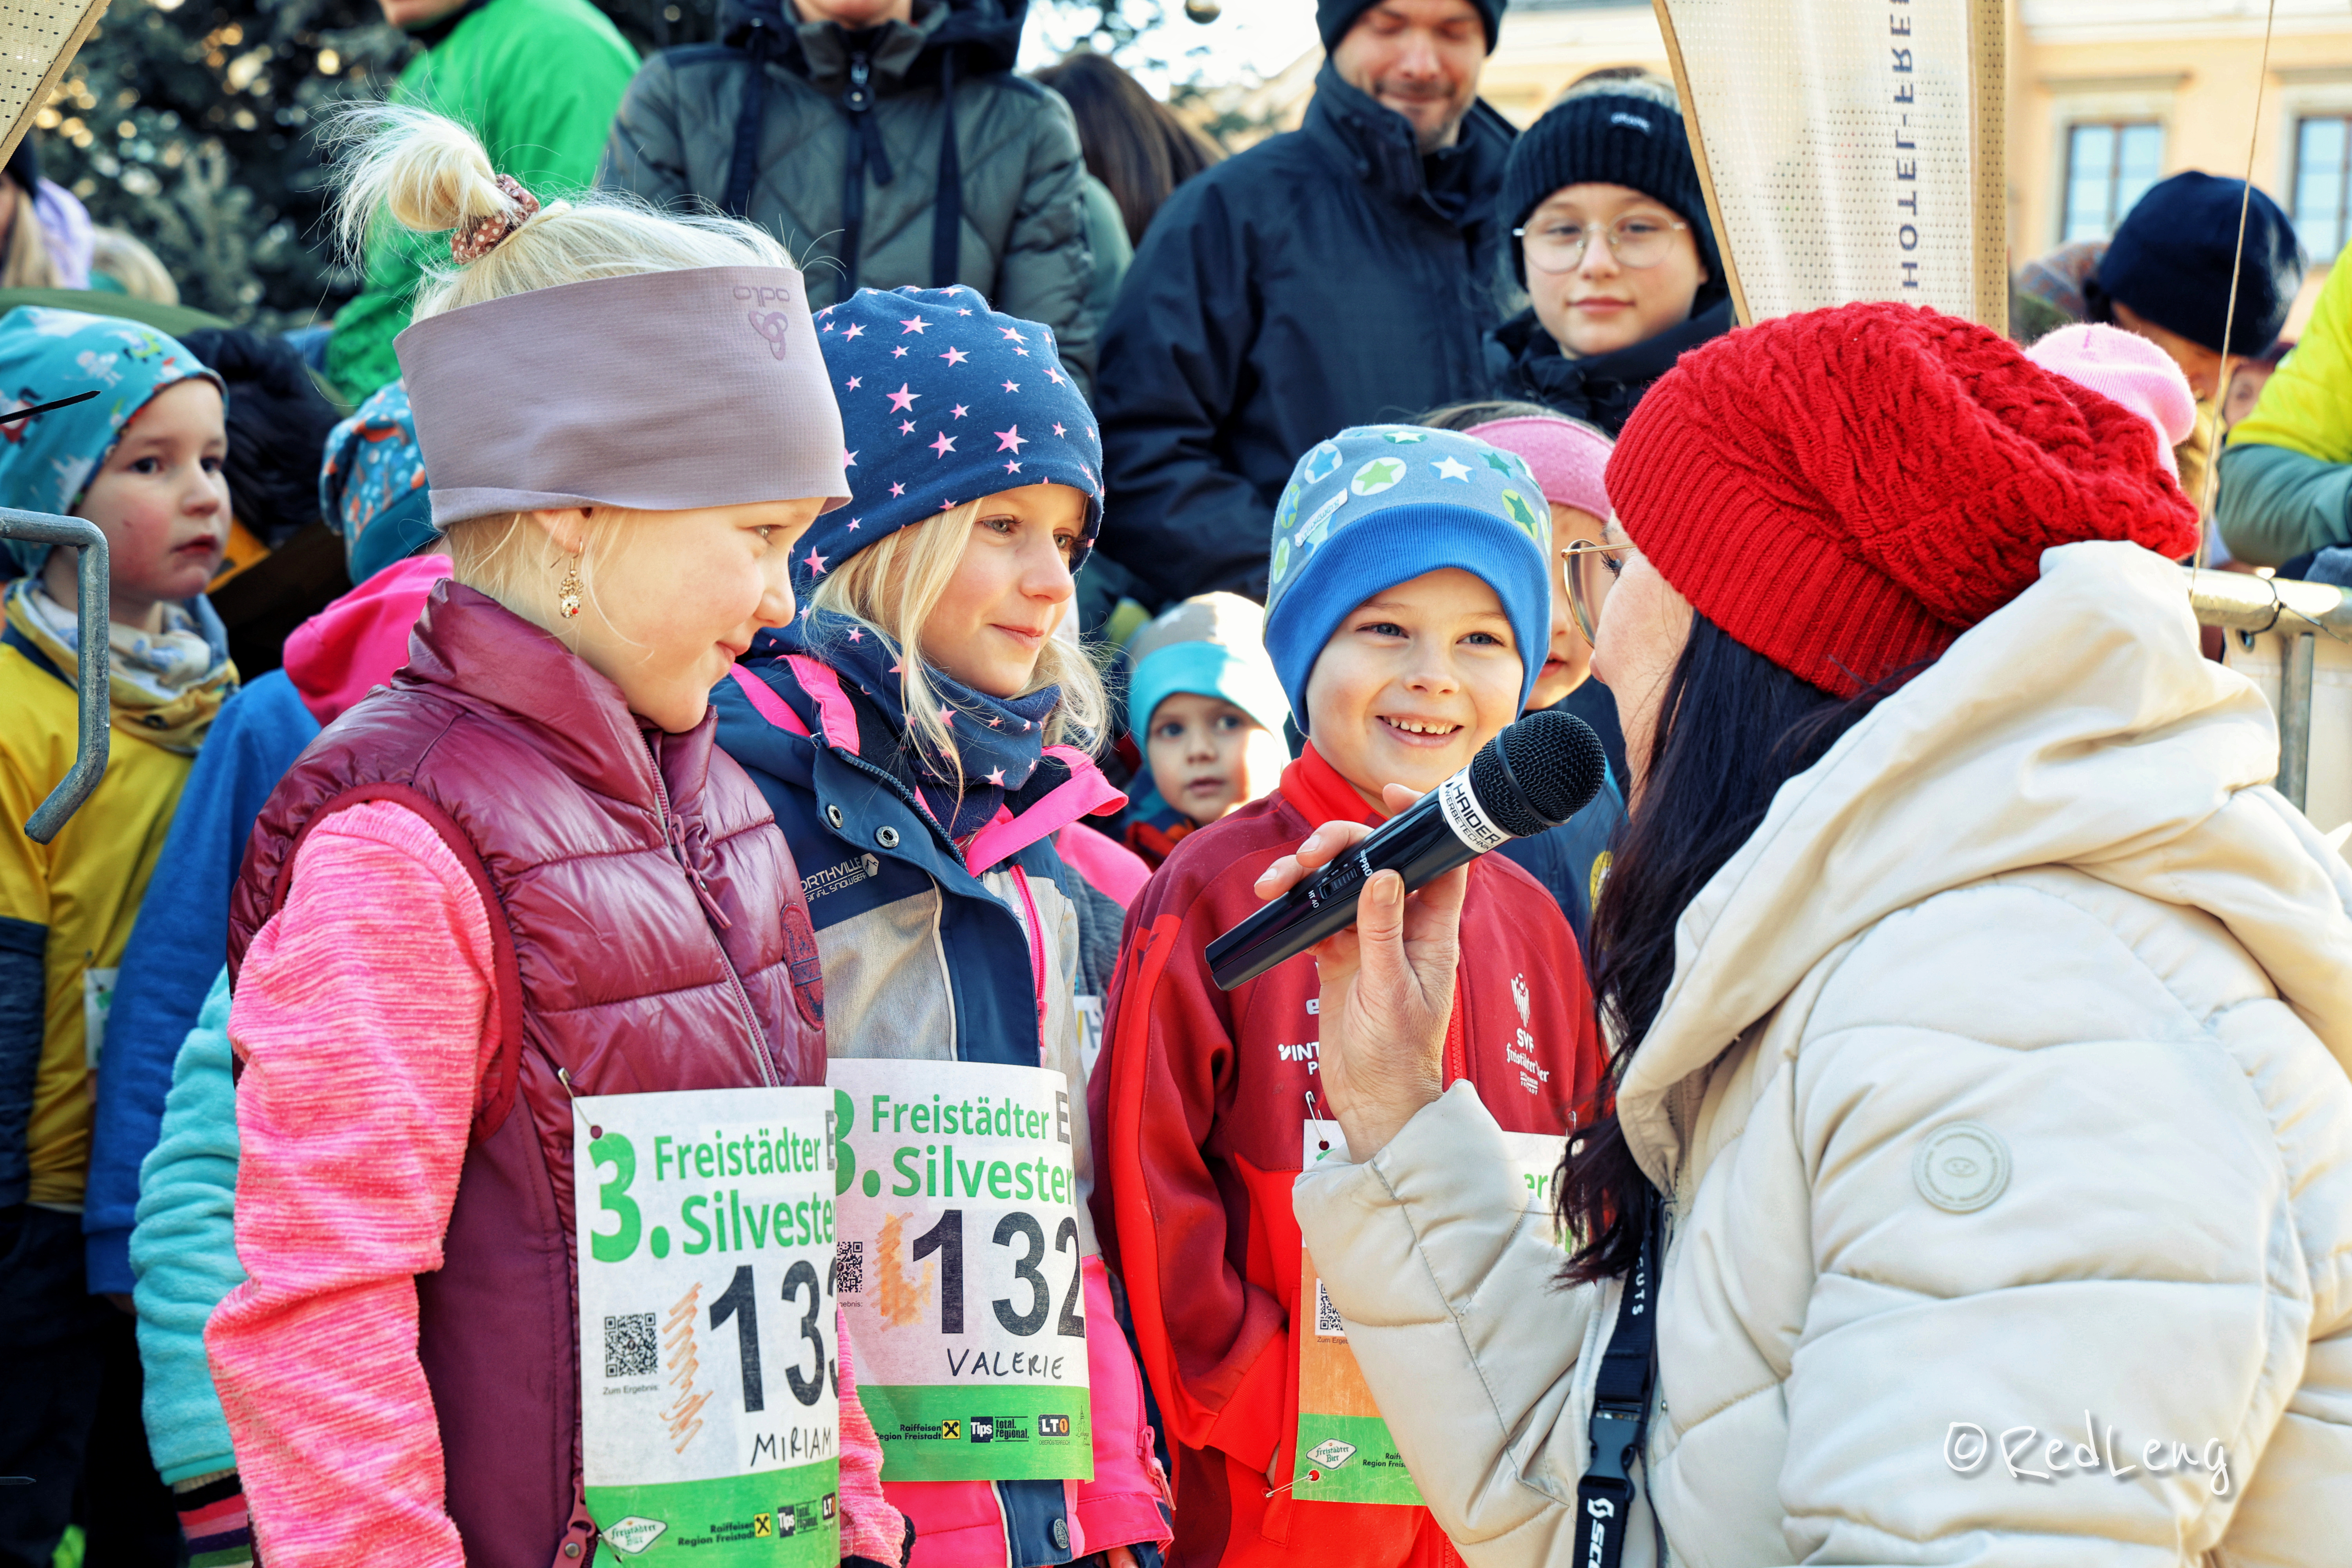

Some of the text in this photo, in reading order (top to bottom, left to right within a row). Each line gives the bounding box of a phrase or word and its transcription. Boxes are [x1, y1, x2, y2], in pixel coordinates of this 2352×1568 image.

[1445, 788, 1493, 850] WERBETECHNIK
[1453, 783, 1501, 844] HAIDER
[1359, 857, 1373, 877] PRO
[1308, 890, 1319, 908] HT 40
[1517, 1027, 1534, 1053] SVF
[872, 1094, 1049, 1139] Freistädter
[655, 1127, 820, 1180] Freistädter
[588, 1132, 670, 1262] 3.
[913, 1209, 1085, 1338] 132
[947, 1348, 1064, 1379] VALERIE
[603, 1387, 621, 1396] Zum
[971, 1422, 993, 1437] Tips
[996, 1419, 1016, 1429] total.
[996, 1428, 1029, 1439] regional.
[1042, 1418, 1068, 1433] LT1
[750, 1427, 831, 1467] MIRIAM
[1327, 1454, 1339, 1463] Bier
[710, 1521, 755, 1534] Raiffeisen
[778, 1512, 795, 1531] Tips
[678, 1531, 755, 1548] Region Freistadt
